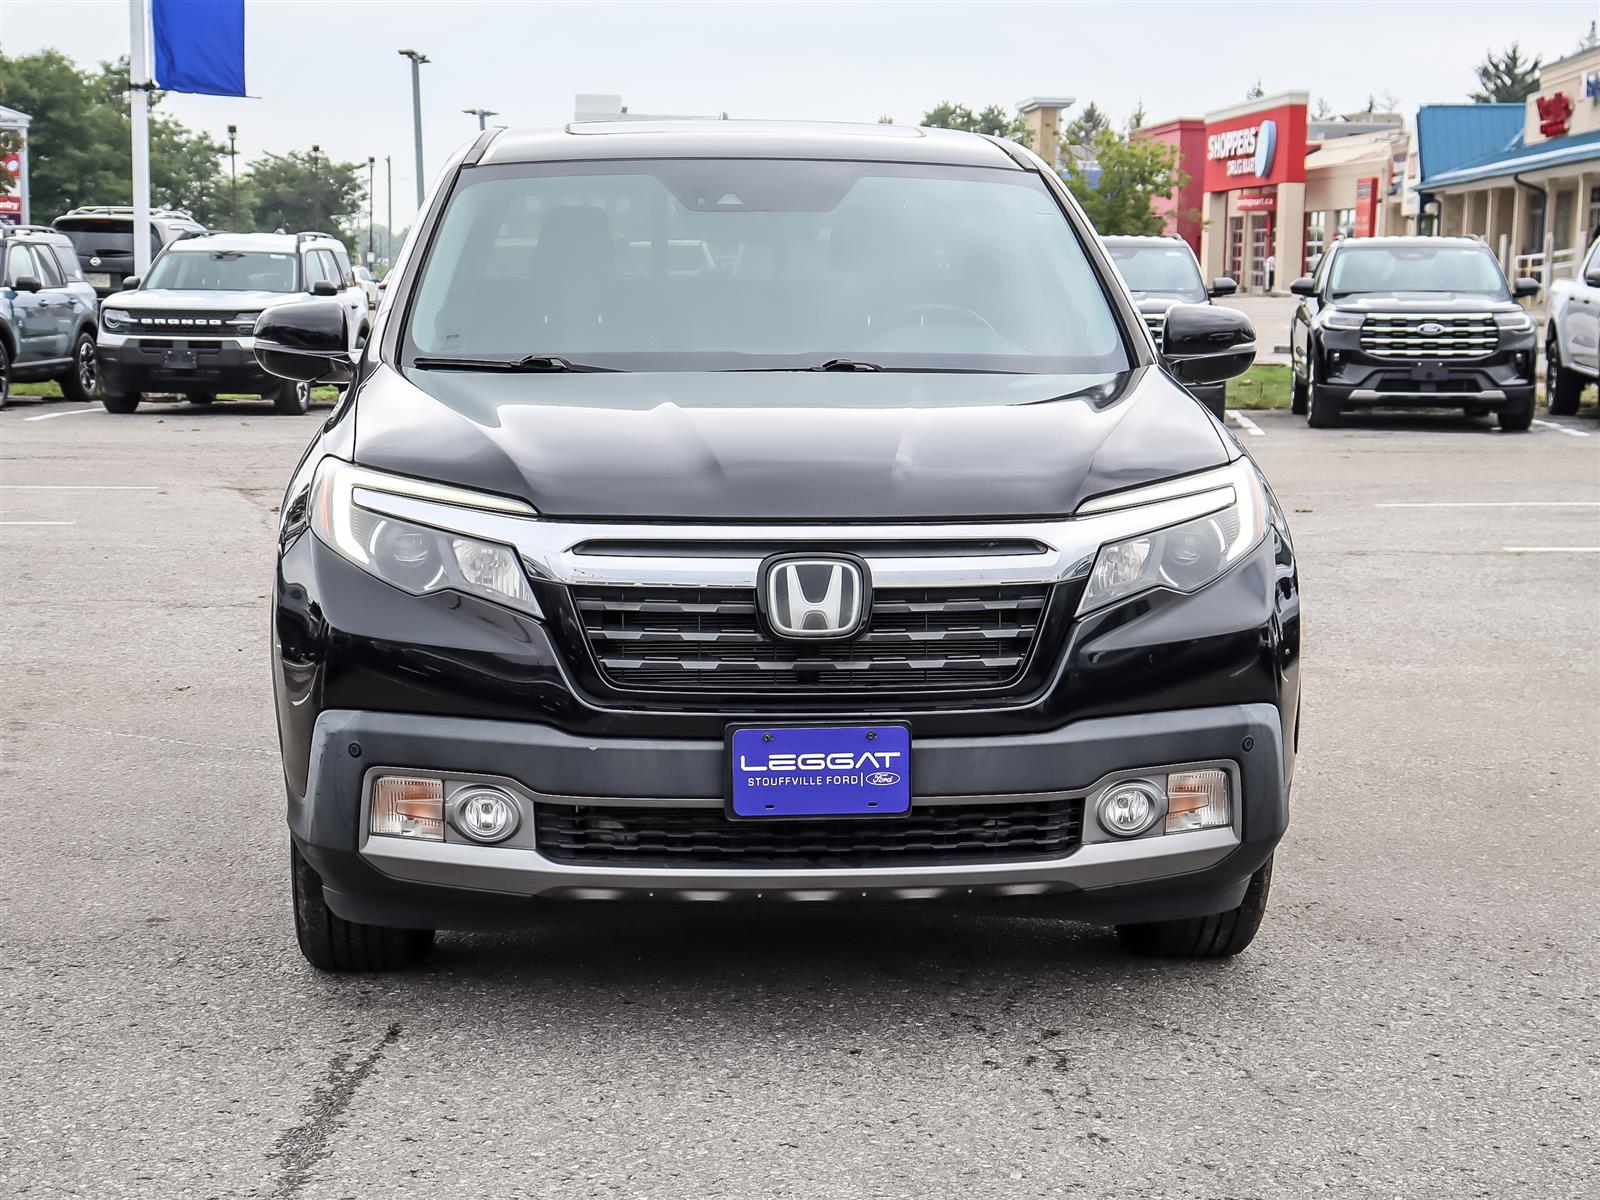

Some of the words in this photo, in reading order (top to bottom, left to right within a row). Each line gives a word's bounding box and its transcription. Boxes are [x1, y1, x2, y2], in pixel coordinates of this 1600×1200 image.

[1207, 126, 1256, 160] SHOPPERS
[1226, 159, 1242, 176] DRUG
[1242, 157, 1256, 174] MAR
[740, 752, 901, 771] LEGGAT
[747, 777, 822, 787] STOUFFVILLE
[826, 775, 858, 785] FORD
